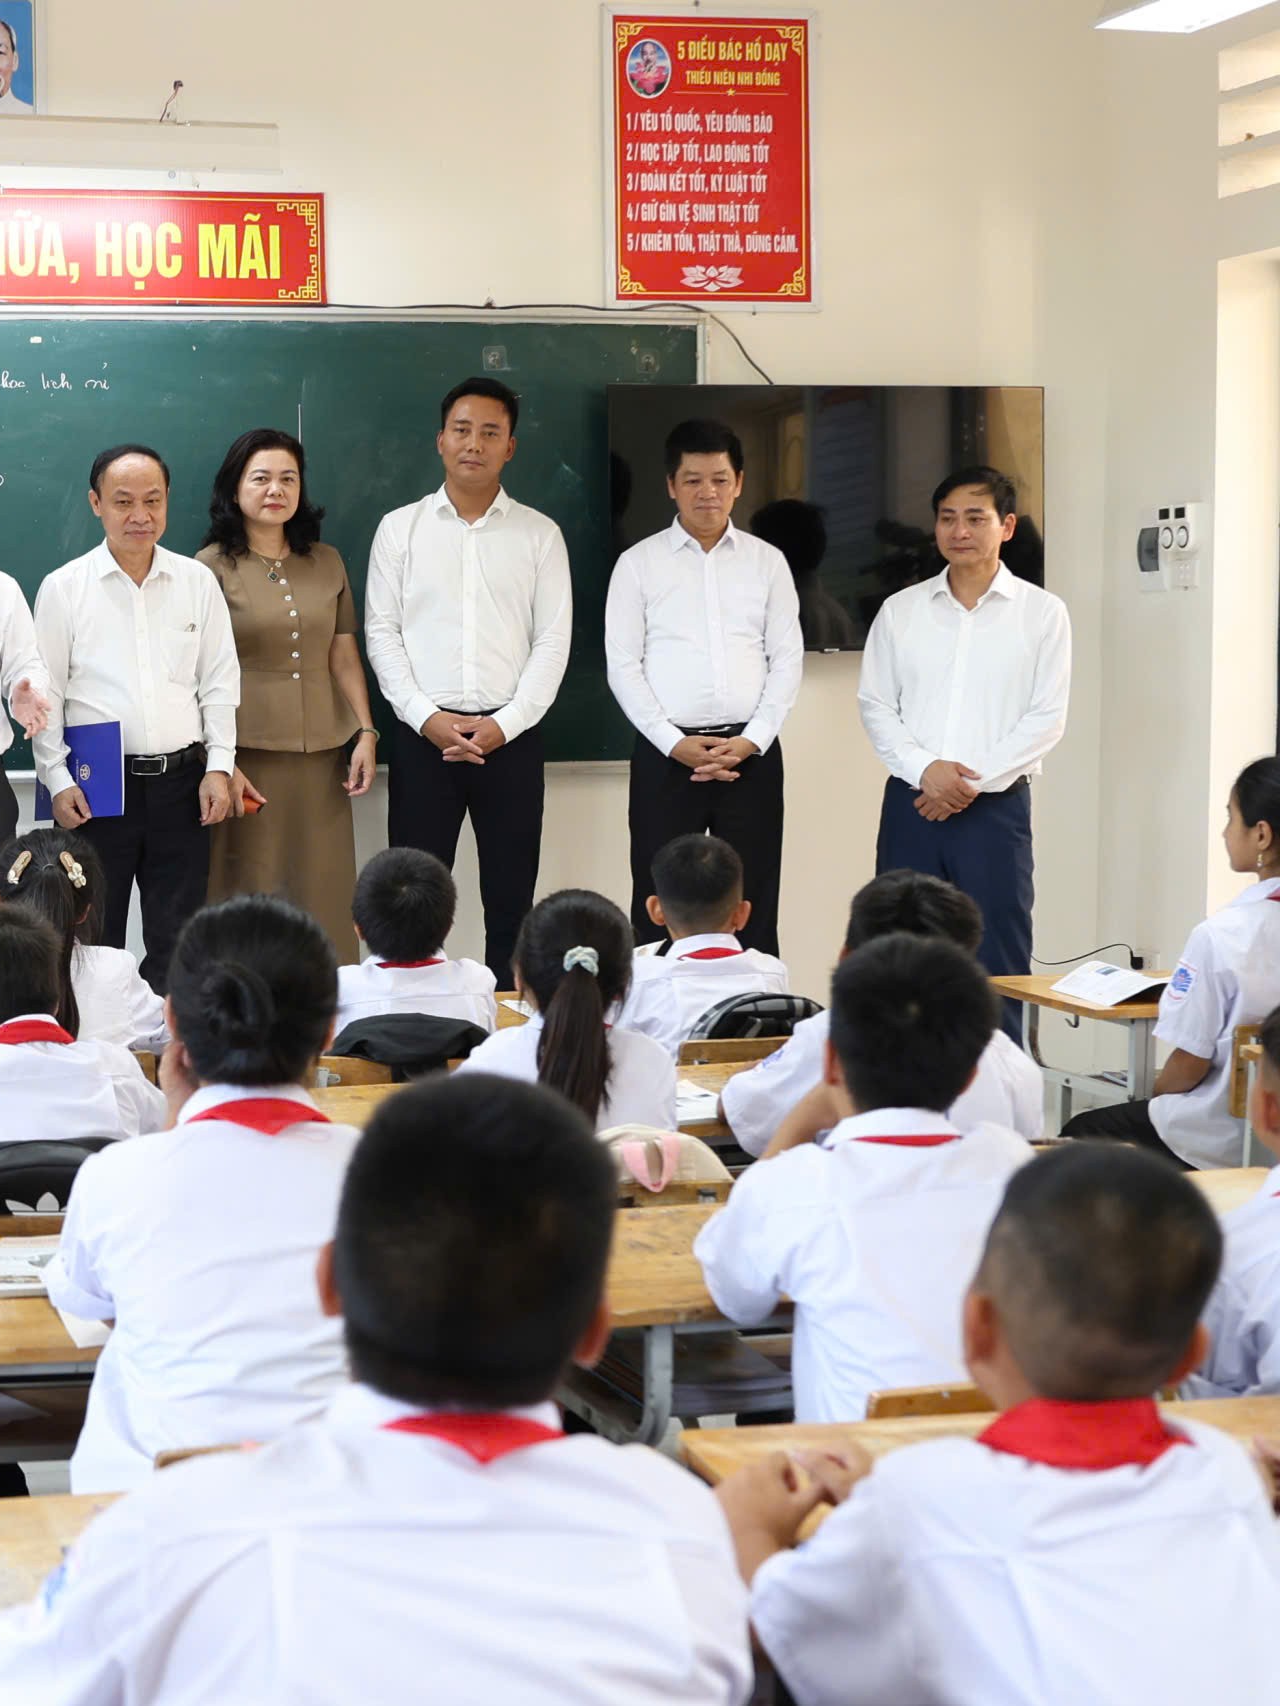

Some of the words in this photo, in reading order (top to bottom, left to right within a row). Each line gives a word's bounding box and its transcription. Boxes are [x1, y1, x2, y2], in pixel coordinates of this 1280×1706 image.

[677, 41, 685, 60] 5
[719, 37, 742, 61] BÁC
[765, 42, 788, 67] DẠY
[686, 66, 712, 85] THIẾU
[714, 68, 735, 85] NIÊN
[737, 72, 753, 85] NHI
[640, 109, 658, 132] YÊU
[660, 106, 673, 132] TỔ
[674, 107, 703, 134] QUỐC,
[705, 110, 723, 132] YÊU
[640, 143, 659, 166] HỌC
[662, 140, 679, 166] TẬP
[682, 137, 702, 164] TỐT,
[704, 144, 722, 162] LAO
[724, 140, 750, 166] ĐỘNG
[752, 138, 769, 163] TỐT
[640, 169, 667, 191] ĐOÀN
[669, 167, 686, 191] KẾT
[689, 167, 708, 194] TỐT,
[710, 166, 723, 192] KỶ
[725, 170, 748, 197] LUẬT
[750, 168, 768, 193] TỐT
[641, 198, 658, 222] GIỮ
[660, 200, 676, 222] GÌN
[678, 200, 690, 226] VỆ
[692, 204, 716, 222] SINH
[718, 201, 741, 227] THẬT
[742, 198, 760, 223] TỐT
[95, 221, 183, 290] HỌC
[198, 212, 281, 279] MÃI
